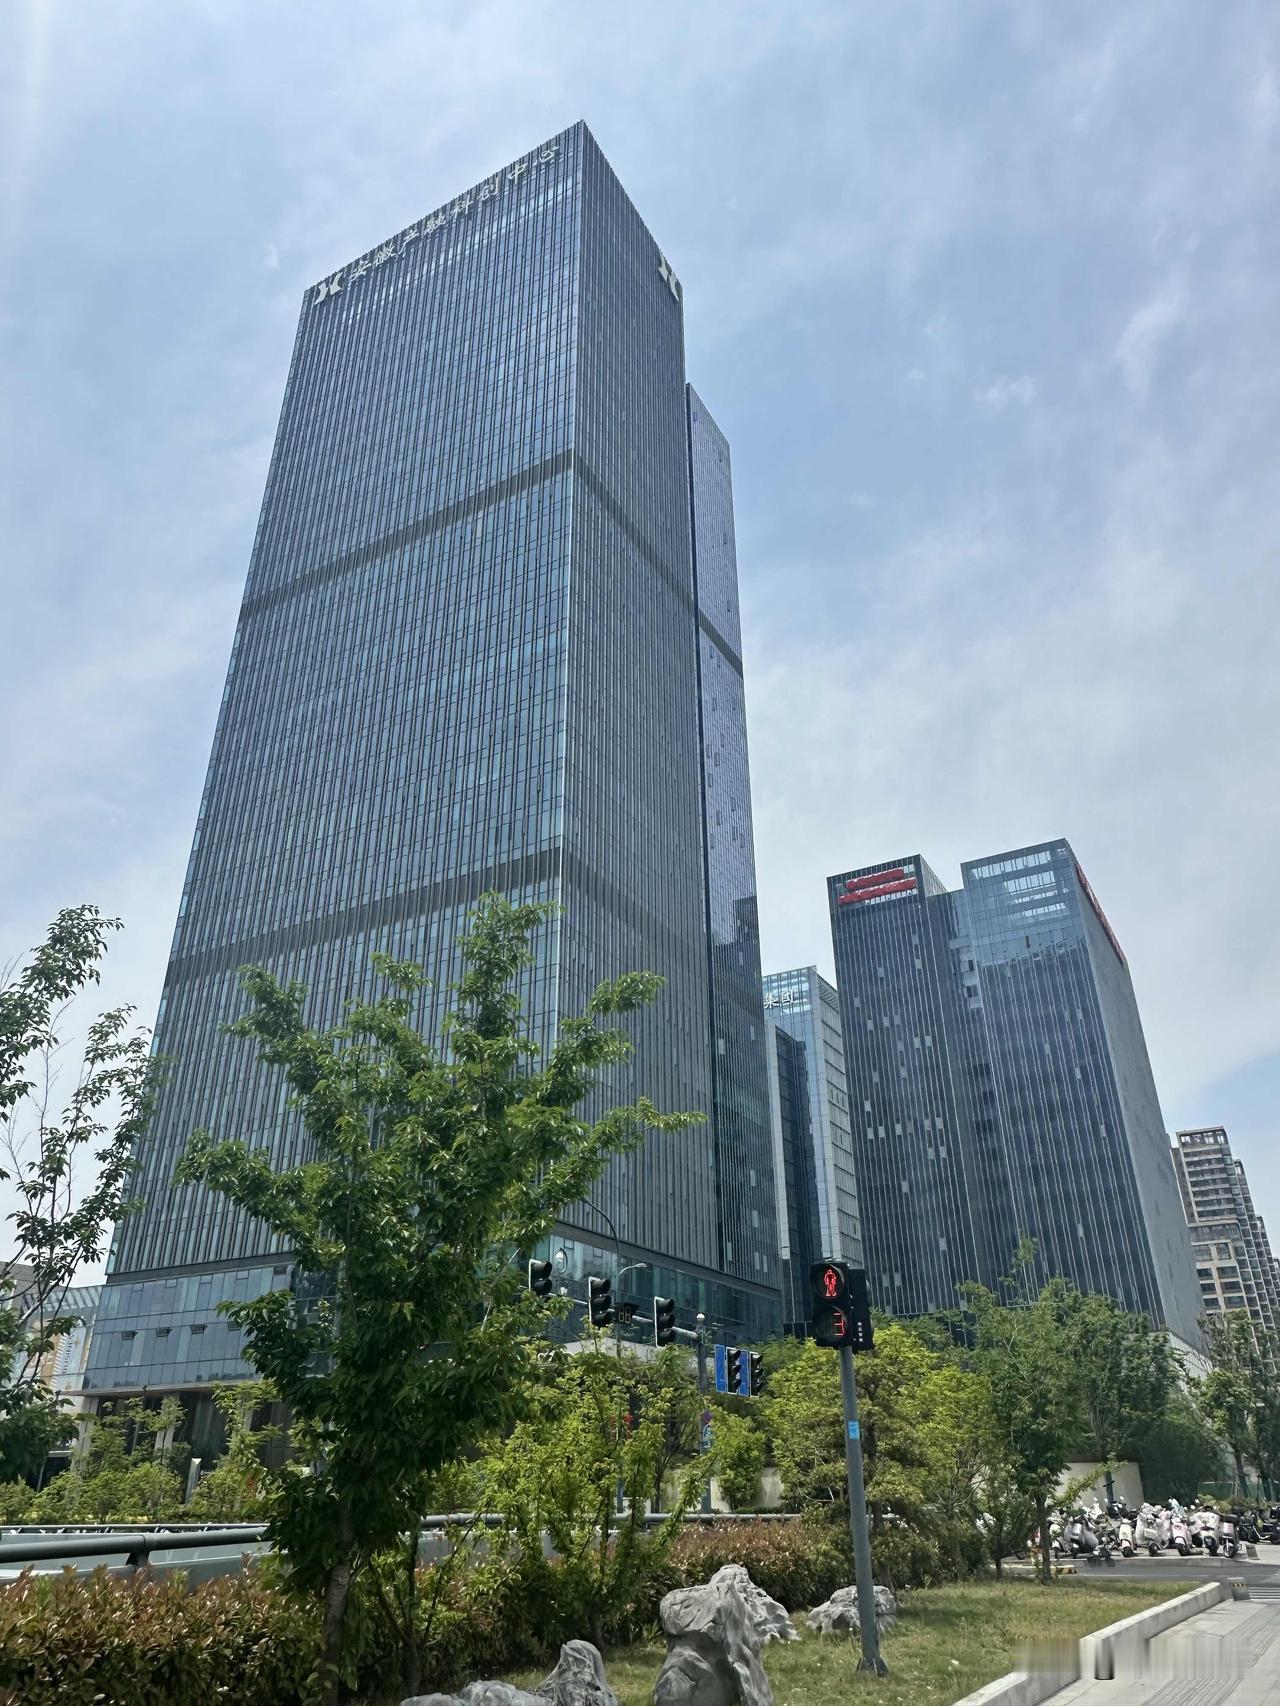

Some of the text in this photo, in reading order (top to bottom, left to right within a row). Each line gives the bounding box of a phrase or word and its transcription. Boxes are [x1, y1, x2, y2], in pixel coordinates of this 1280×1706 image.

[349, 146, 560, 282] 安徽产融科创中心
